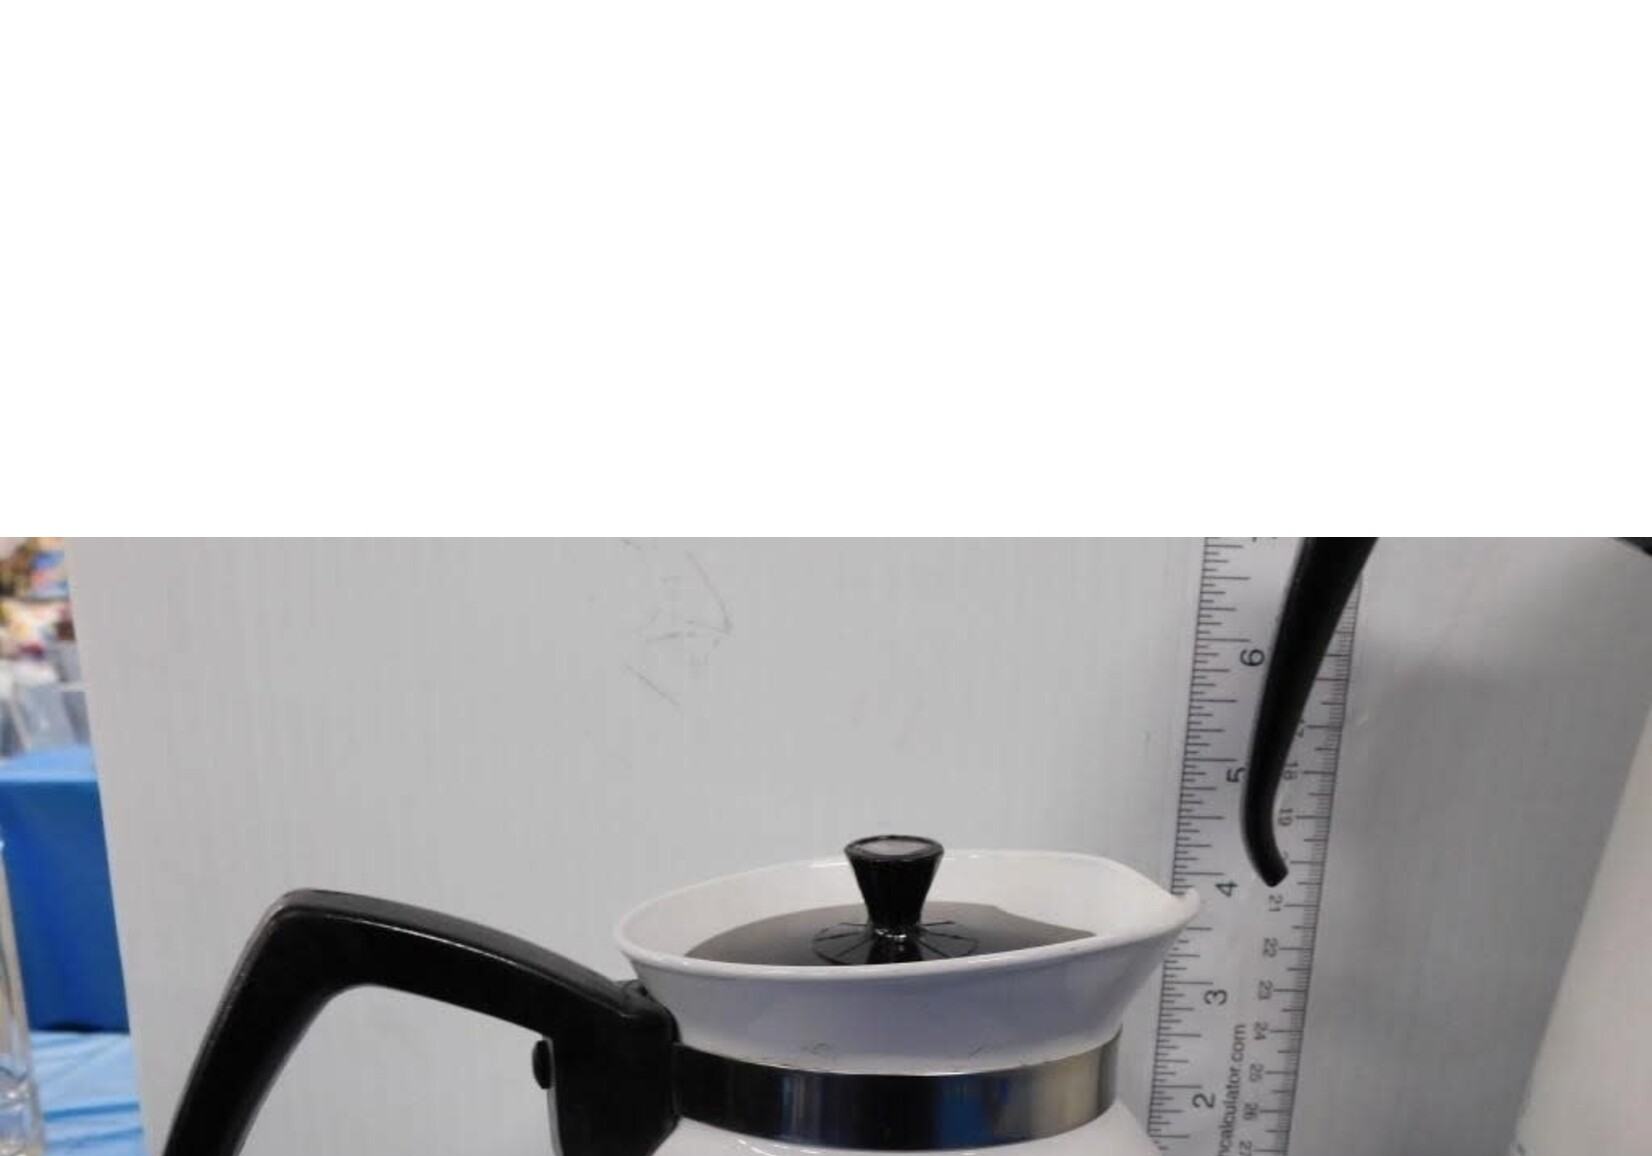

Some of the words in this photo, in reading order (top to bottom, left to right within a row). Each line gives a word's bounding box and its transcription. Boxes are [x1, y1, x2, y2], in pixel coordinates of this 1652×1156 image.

[1239, 648, 1266, 667] 6
[1226, 767, 1246, 783] 5
[1282, 761, 1299, 781] 18
[1277, 807, 1294, 827] 19
[1215, 880, 1239, 898] 4
[1268, 894, 1284, 912] 21
[1204, 989, 1228, 1006] 3
[1253, 1021, 1270, 1041] 24
[1249, 1062, 1265, 1083] 25
[1191, 1092, 1216, 1109] 2
[1242, 1102, 1259, 1121] 26
